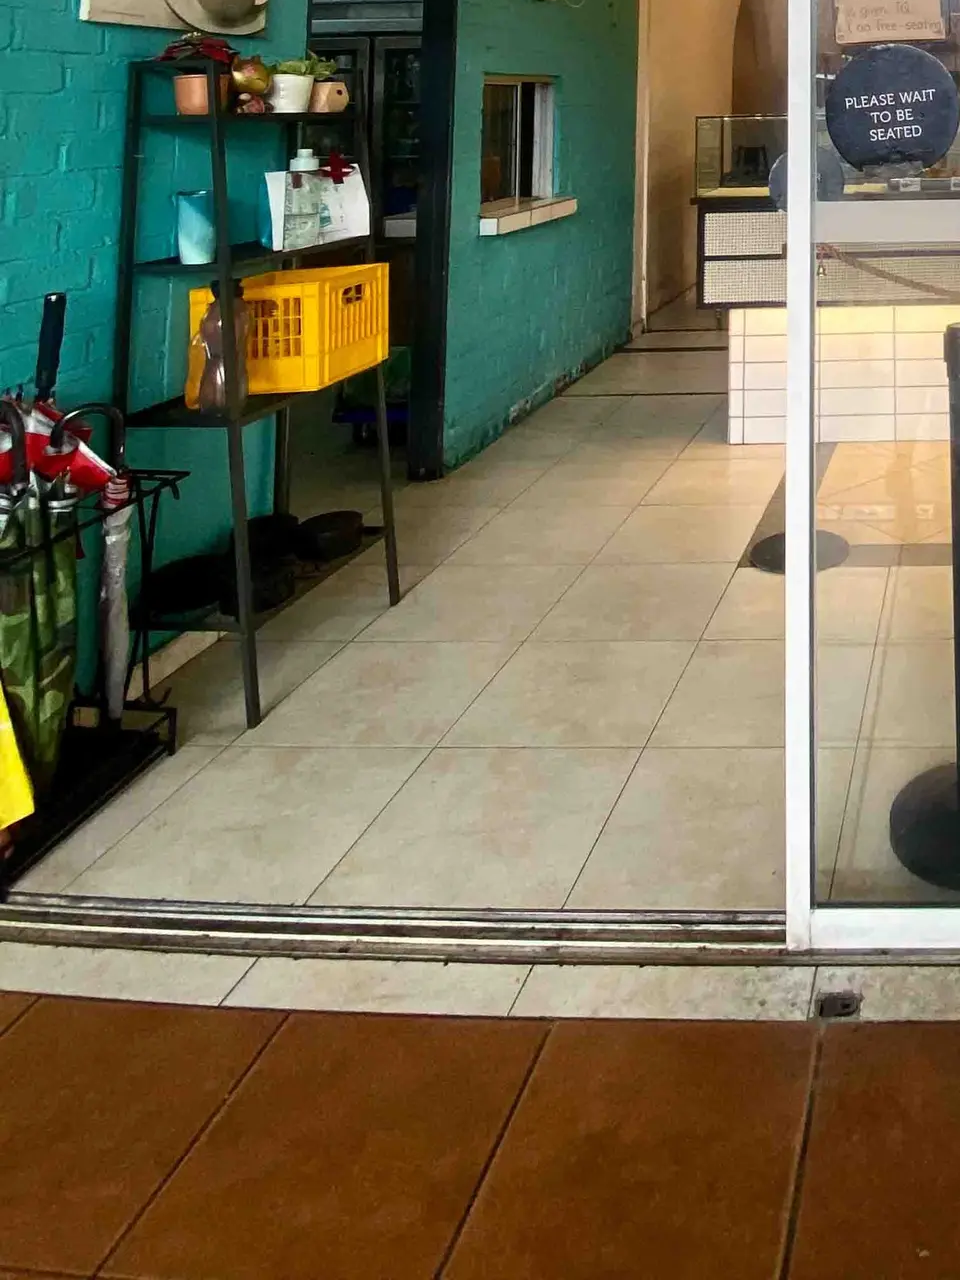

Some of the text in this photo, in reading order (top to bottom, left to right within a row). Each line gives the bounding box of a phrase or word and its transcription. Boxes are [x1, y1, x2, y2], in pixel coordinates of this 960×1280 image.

[845, 88, 936, 109] PLEASE WAIT
[870, 109, 914, 123] TO BE
[869, 125, 922, 141] SEATED
